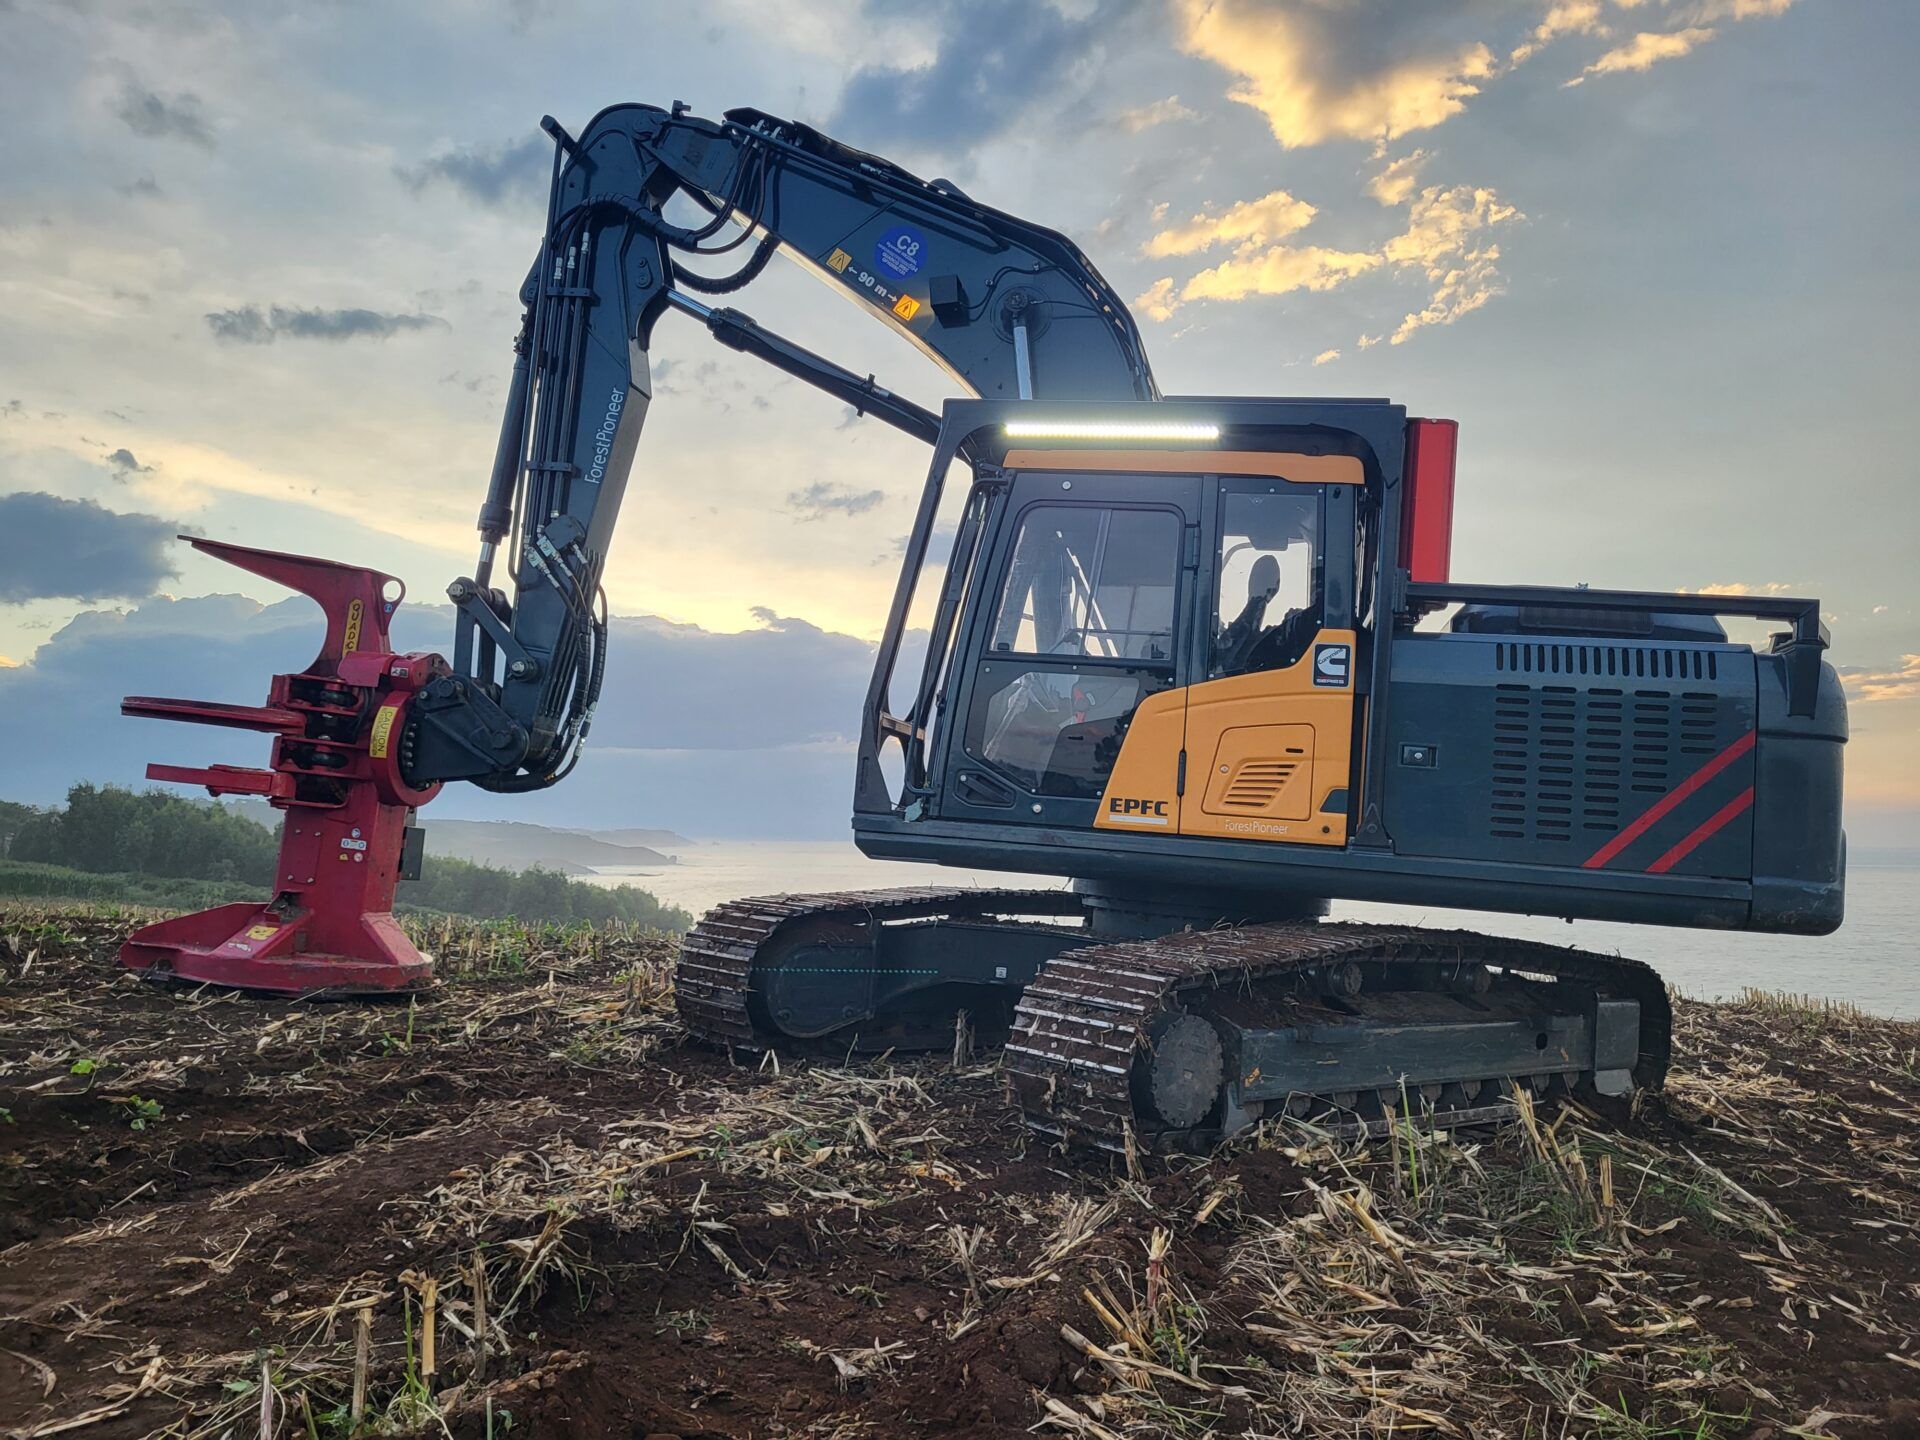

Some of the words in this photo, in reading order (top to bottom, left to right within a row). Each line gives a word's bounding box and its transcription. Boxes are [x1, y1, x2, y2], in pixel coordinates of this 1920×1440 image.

[896, 235, 920, 256] C8
[858, 271, 875, 287] 90
[874, 284, 887, 297] m
[584, 387, 625, 484] ForestPioneer
[345, 603, 361, 650] QUADC
[377, 710, 393, 753] CAUTION
[1109, 797, 1169, 816] EPFC
[1224, 819, 1289, 835] ForestPioneer
